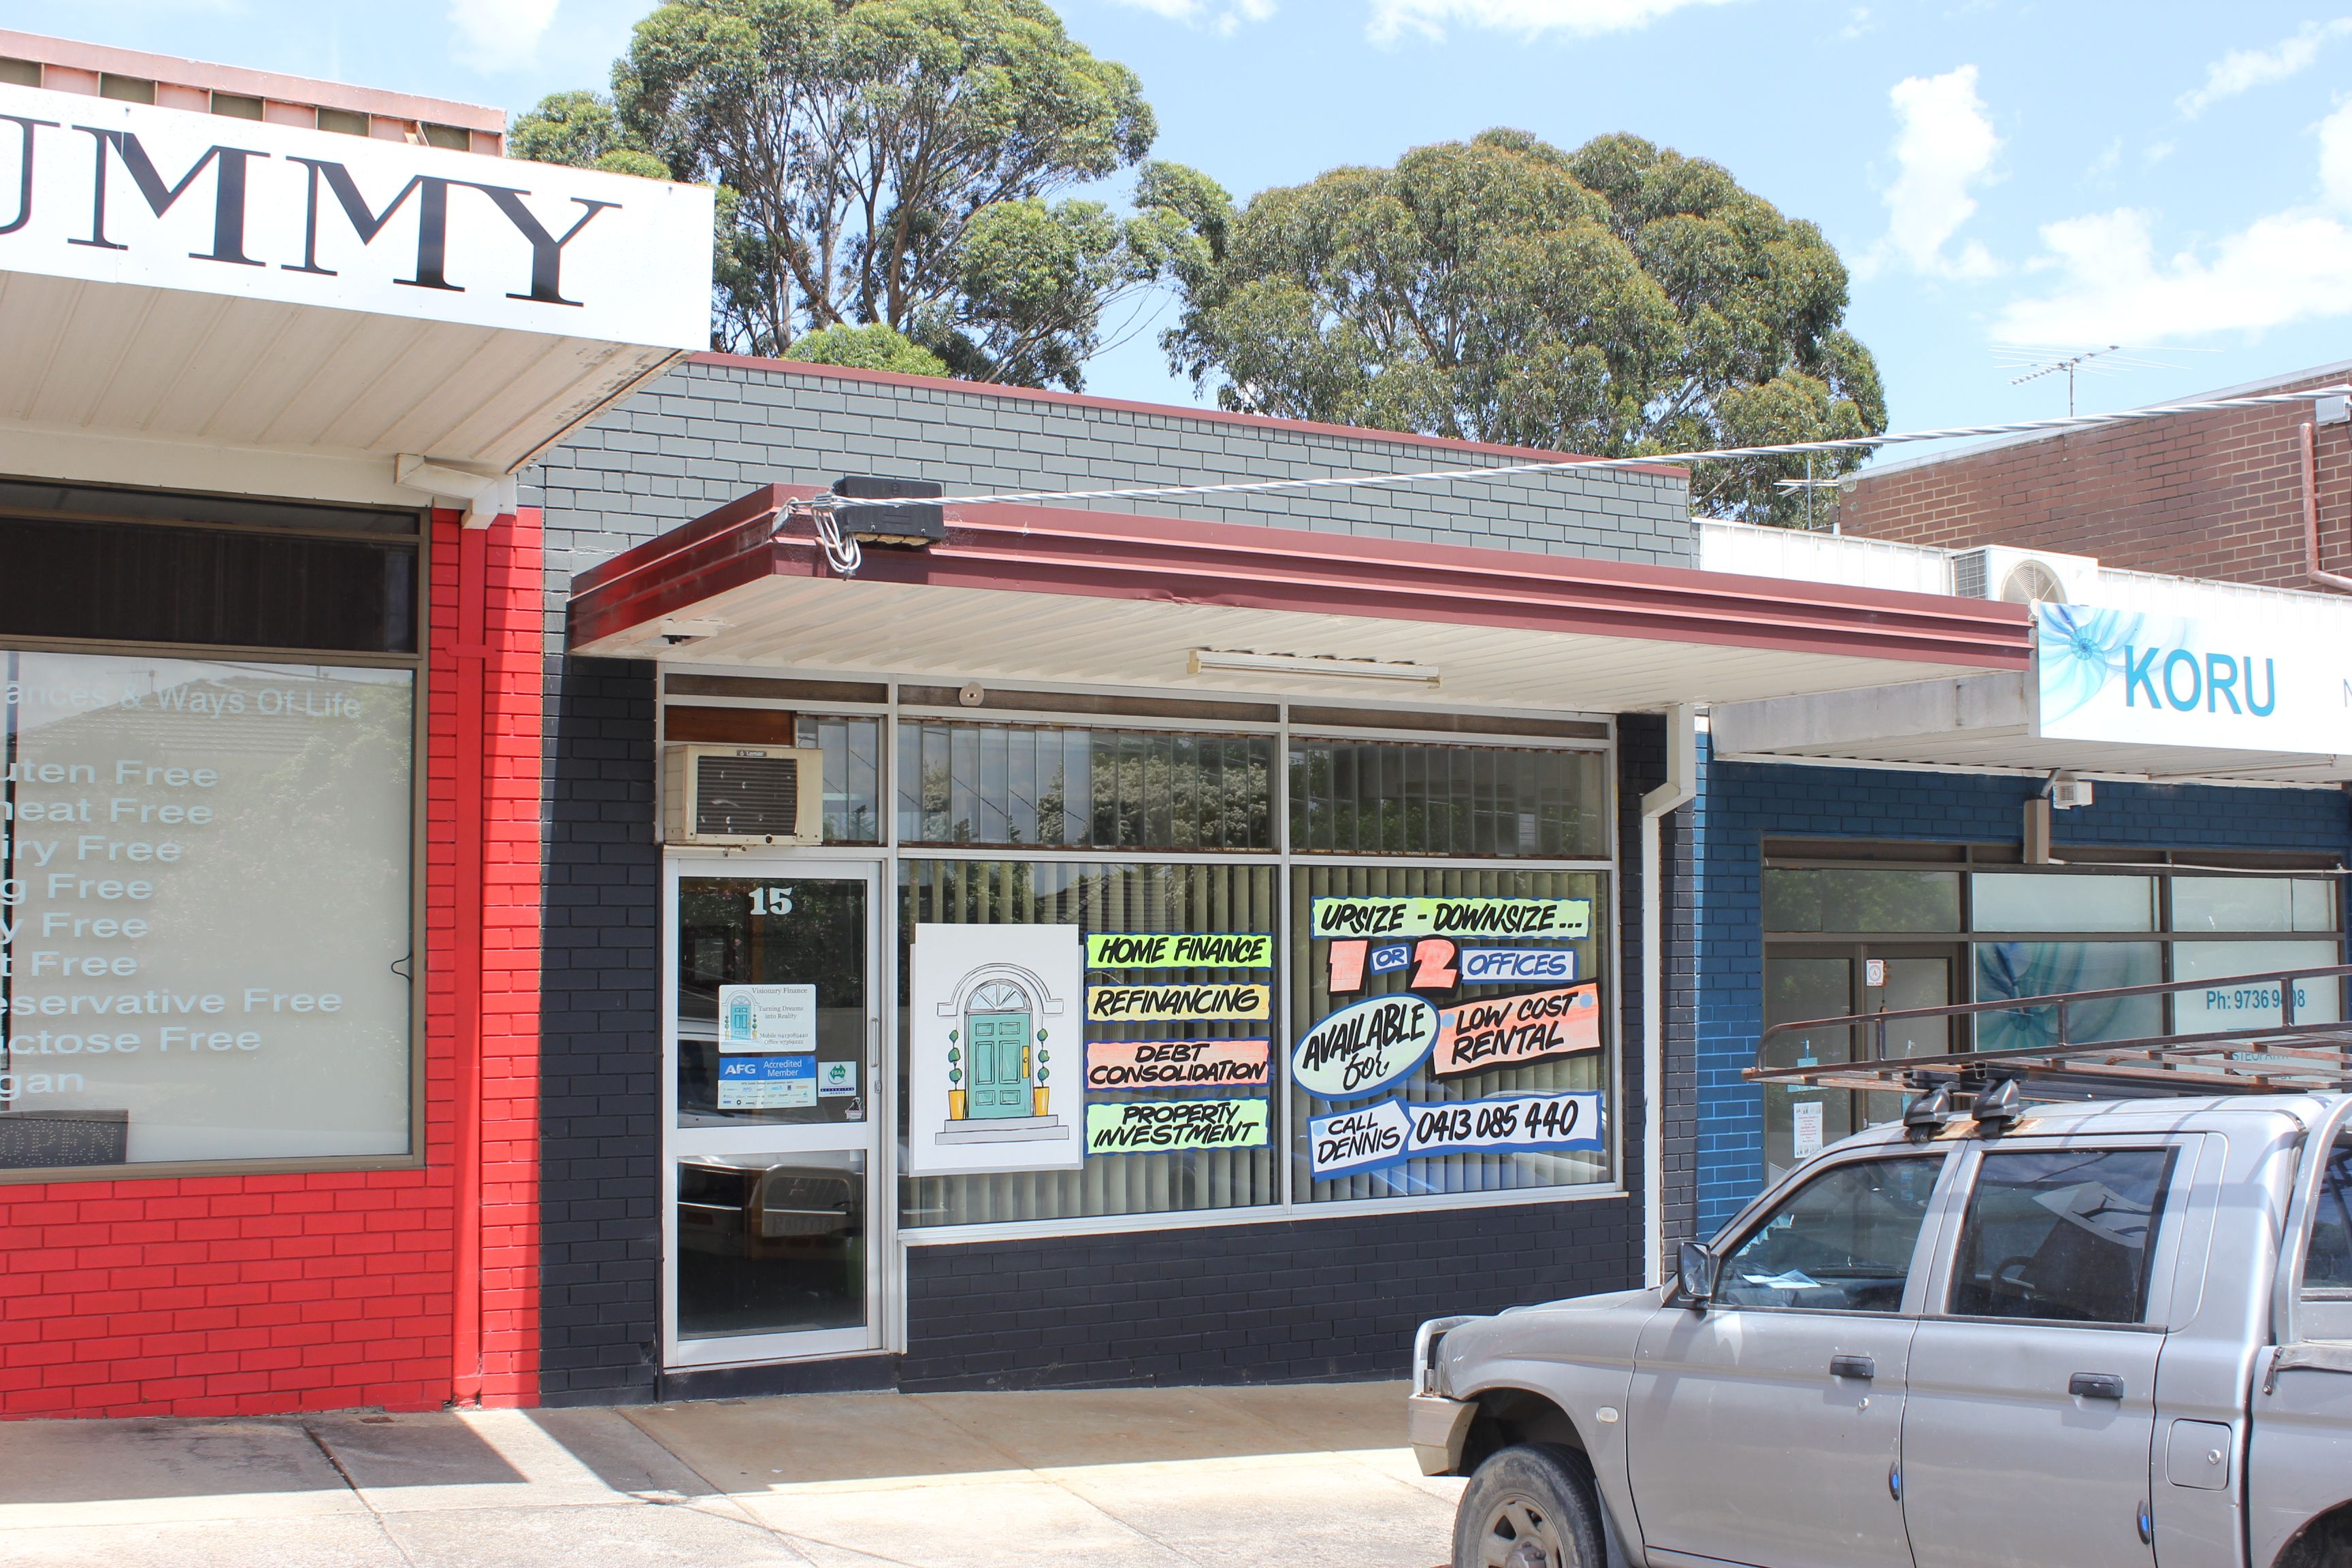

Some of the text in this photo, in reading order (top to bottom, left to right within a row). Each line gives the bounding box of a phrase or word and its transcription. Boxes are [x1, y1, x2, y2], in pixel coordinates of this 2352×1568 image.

[2124, 644, 2276, 717] KORU
[120, 683, 142, 709] &
[157, 685, 245, 719] Ways
[257, 688, 295, 715] Of
[306, 691, 361, 718] Life
[116, 760, 218, 787] Free
[110, 798, 214, 825] Free
[78, 835, 183, 862] Free
[48, 873, 154, 900] Free
[748, 887, 793, 916] 15
[42, 912, 149, 938] Free
[1321, 904, 1407, 934] UPSIZE
[1098, 936, 1267, 964] HOME FINANCE
[31, 951, 137, 977] Free
[1328, 938, 1567, 992] 1 OR 2 OFFICES
[244, 988, 342, 1013] Free
[1093, 987, 1259, 1017] REFINANCING
[1456, 992, 1578, 1034] LOW COST
[2206, 989, 2306, 1010] Ph: 9736 98
[0, 1026, 262, 1054] ctose Free
[1302, 1003, 1426, 1071] AVAILABLE
[1451, 1021, 1565, 1065] RENTAL
[763, 1059, 802, 1068] Accredited
[1134, 1044, 1210, 1063] DEBT
[725, 1064, 756, 1075] AFG
[767, 1068, 799, 1077] Member
[1089, 1060, 1267, 1085] CONSOLIDATION
[1343, 1051, 1390, 1090] for
[1122, 1102, 1241, 1124] PROPERTY
[1328, 1112, 1379, 1136] CALL
[1416, 1100, 1578, 1144] 0413 085 440
[1093, 1122, 1259, 1148] INVESTMENT
[1317, 1127, 1401, 1164] DENNIS
